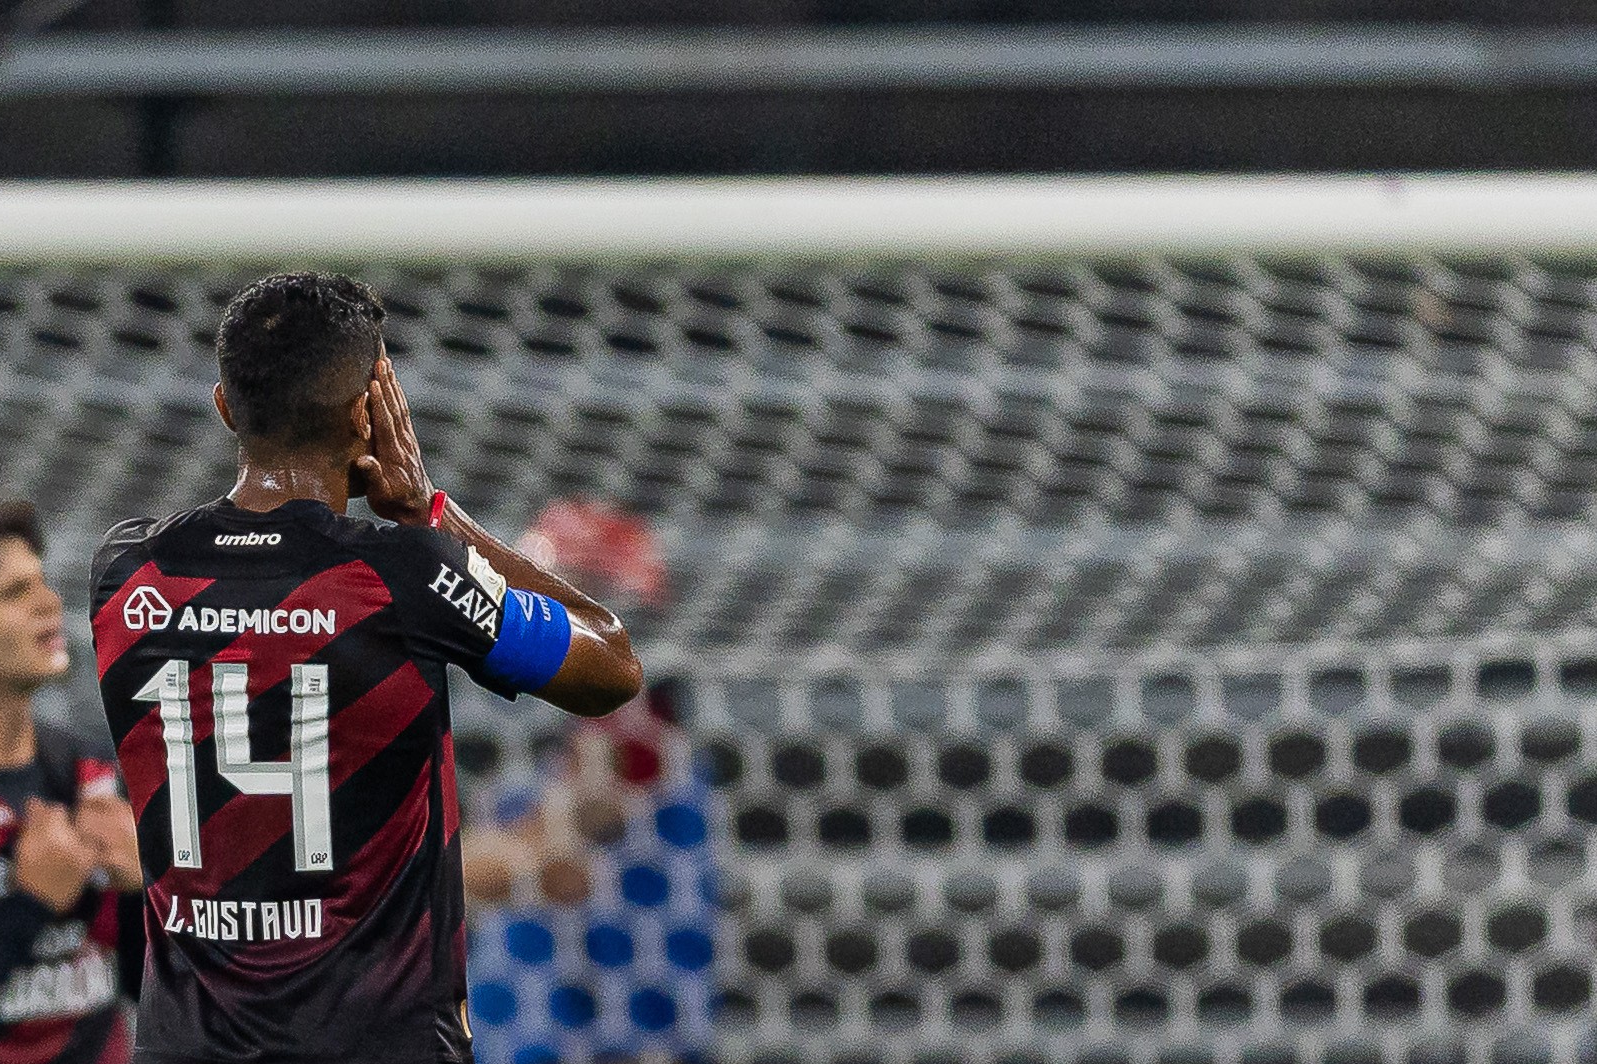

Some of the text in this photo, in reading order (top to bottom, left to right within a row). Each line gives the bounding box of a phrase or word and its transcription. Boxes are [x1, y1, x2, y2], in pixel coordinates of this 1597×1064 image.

[213, 531, 282, 546] umbro
[177, 606, 337, 636] ADEMICON
[427, 562, 499, 642] HAVA
[131, 658, 334, 872] 14
